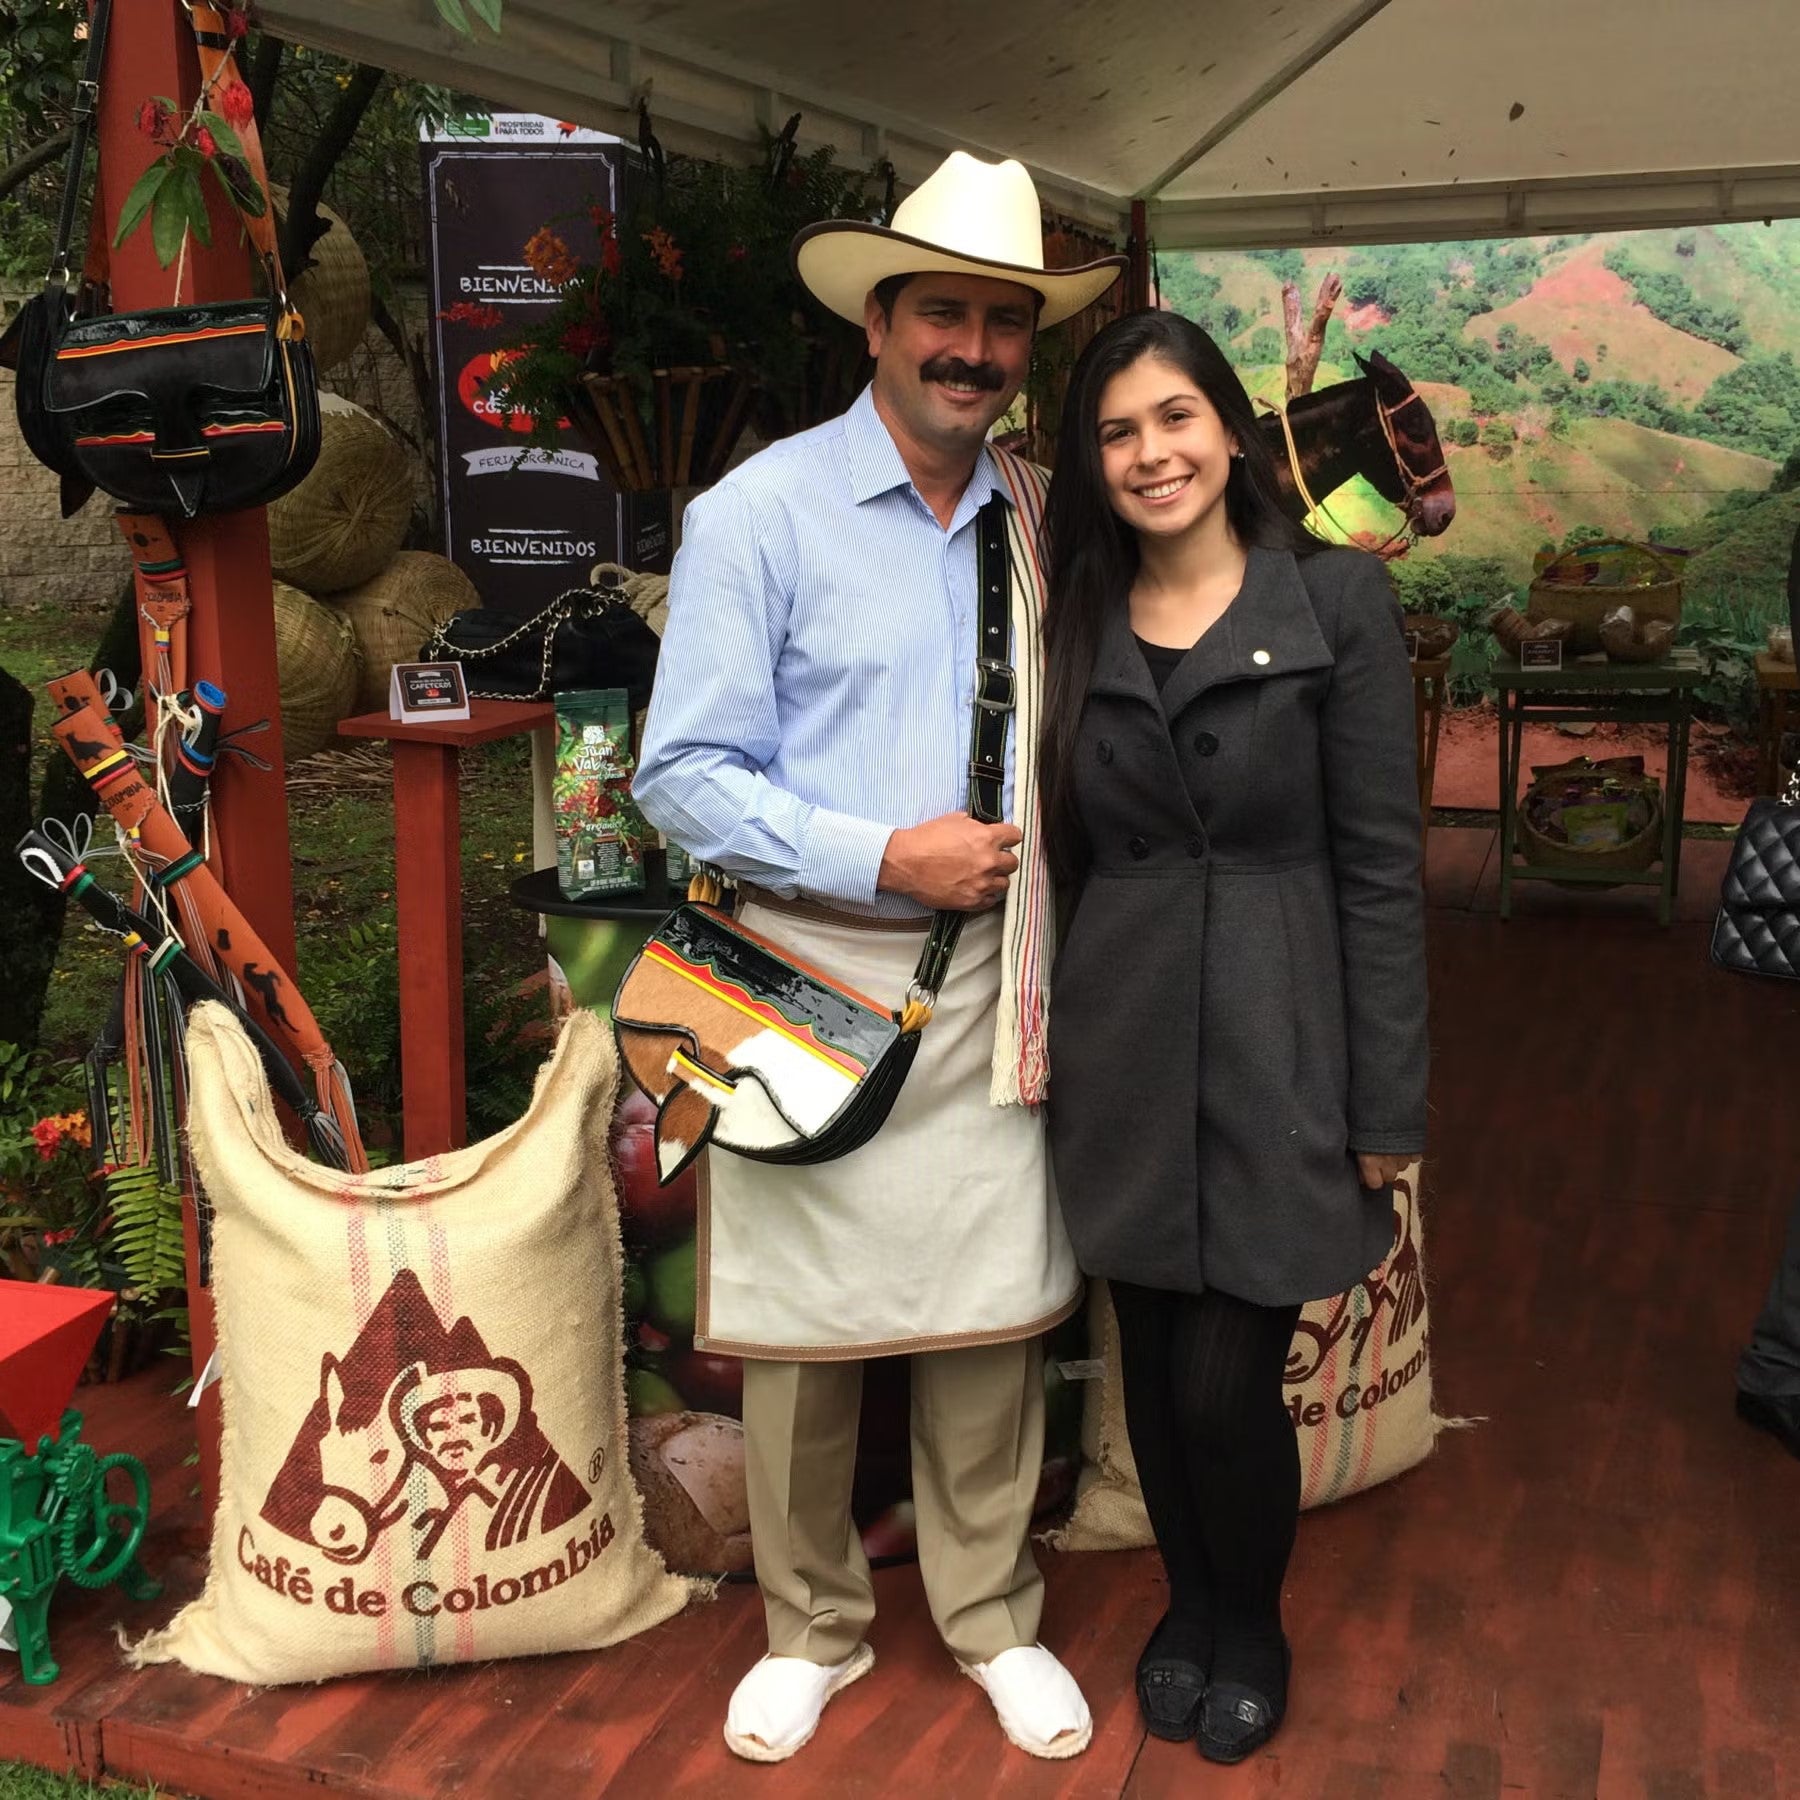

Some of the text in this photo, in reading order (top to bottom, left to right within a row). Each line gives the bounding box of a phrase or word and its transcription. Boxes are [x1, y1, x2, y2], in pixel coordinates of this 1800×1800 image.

[518, 454, 585, 471] ORGNICA
[471, 538, 597, 557] BIENVENIDOS
[577, 745, 613, 758] Juan
[238, 1512, 616, 1617] Café de Colombia
